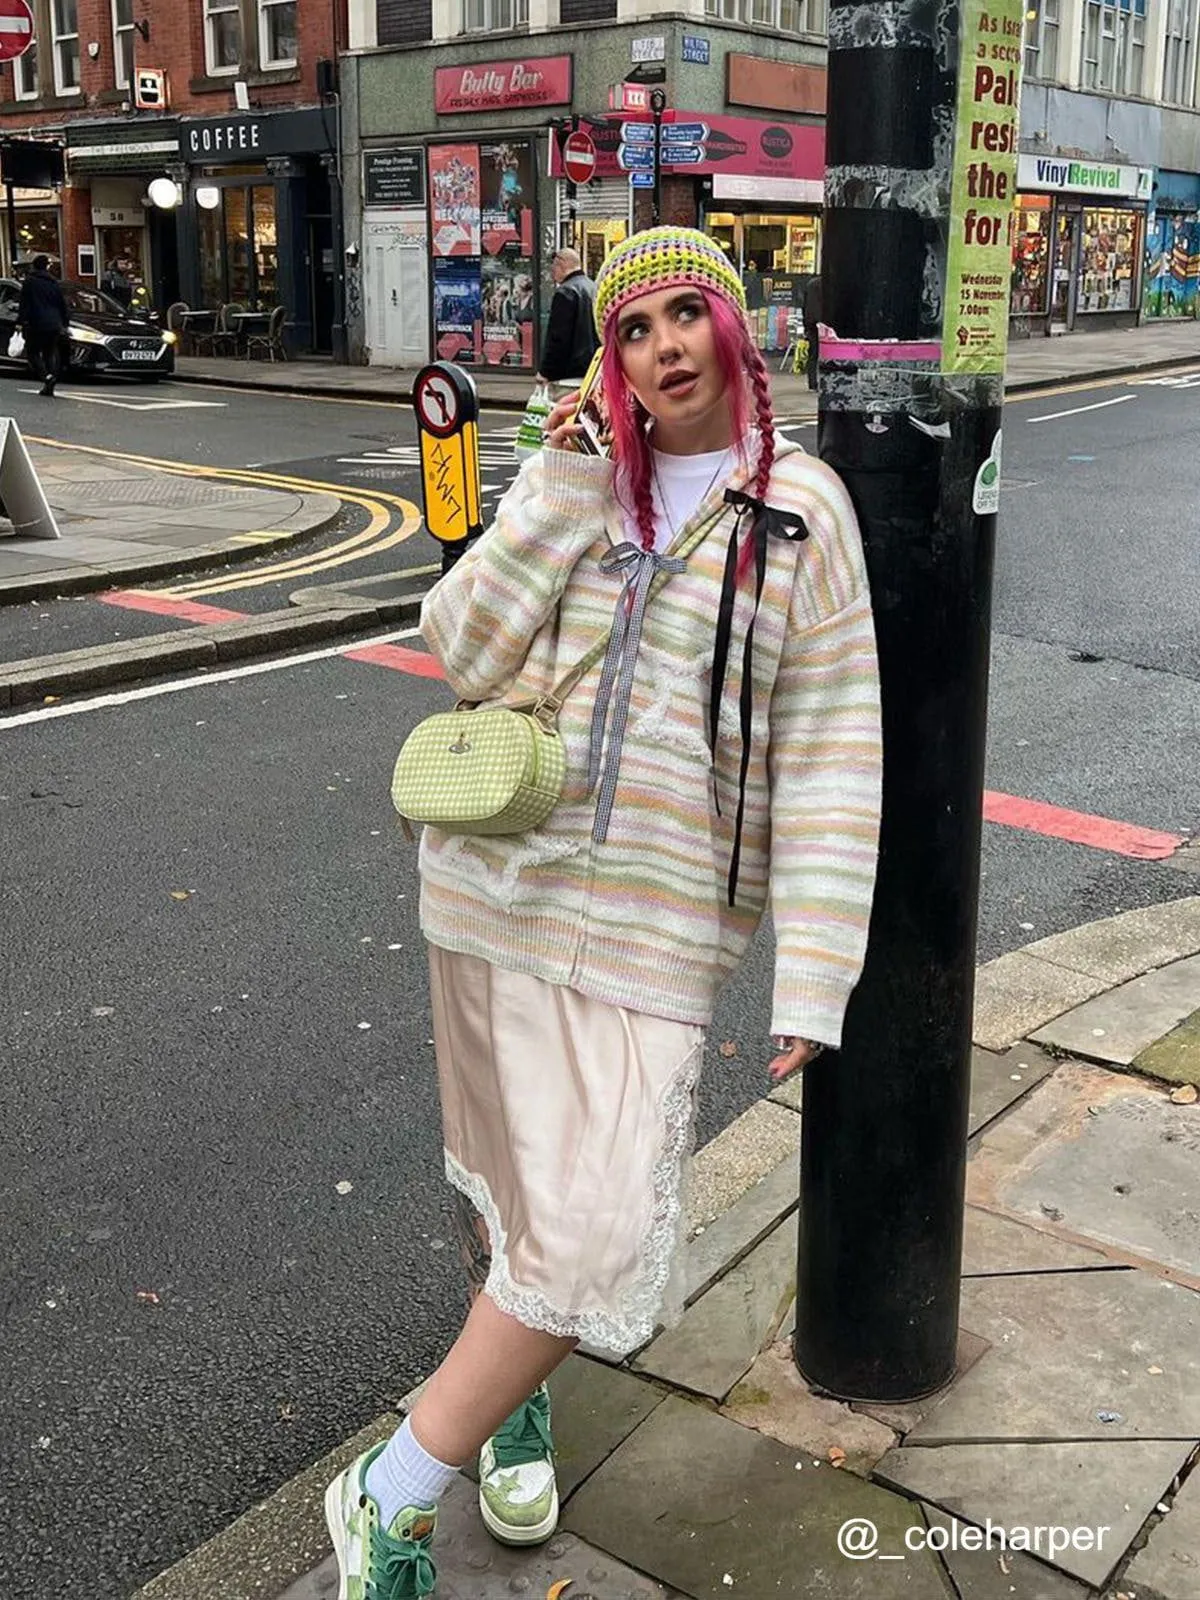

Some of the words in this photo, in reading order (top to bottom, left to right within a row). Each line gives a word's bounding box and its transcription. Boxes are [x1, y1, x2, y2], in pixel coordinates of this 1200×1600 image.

[978, 12, 998, 33] As
[683, 49, 709, 62] STREET
[977, 43, 986, 58] a
[460, 70, 505, 95] Butty
[510, 64, 543, 91] Bar
[190, 125, 259, 151] COFFEE
[970, 118, 1017, 153] resi
[968, 162, 1007, 199] the
[964, 208, 1001, 245] for
[960, 289, 971, 299] 15
